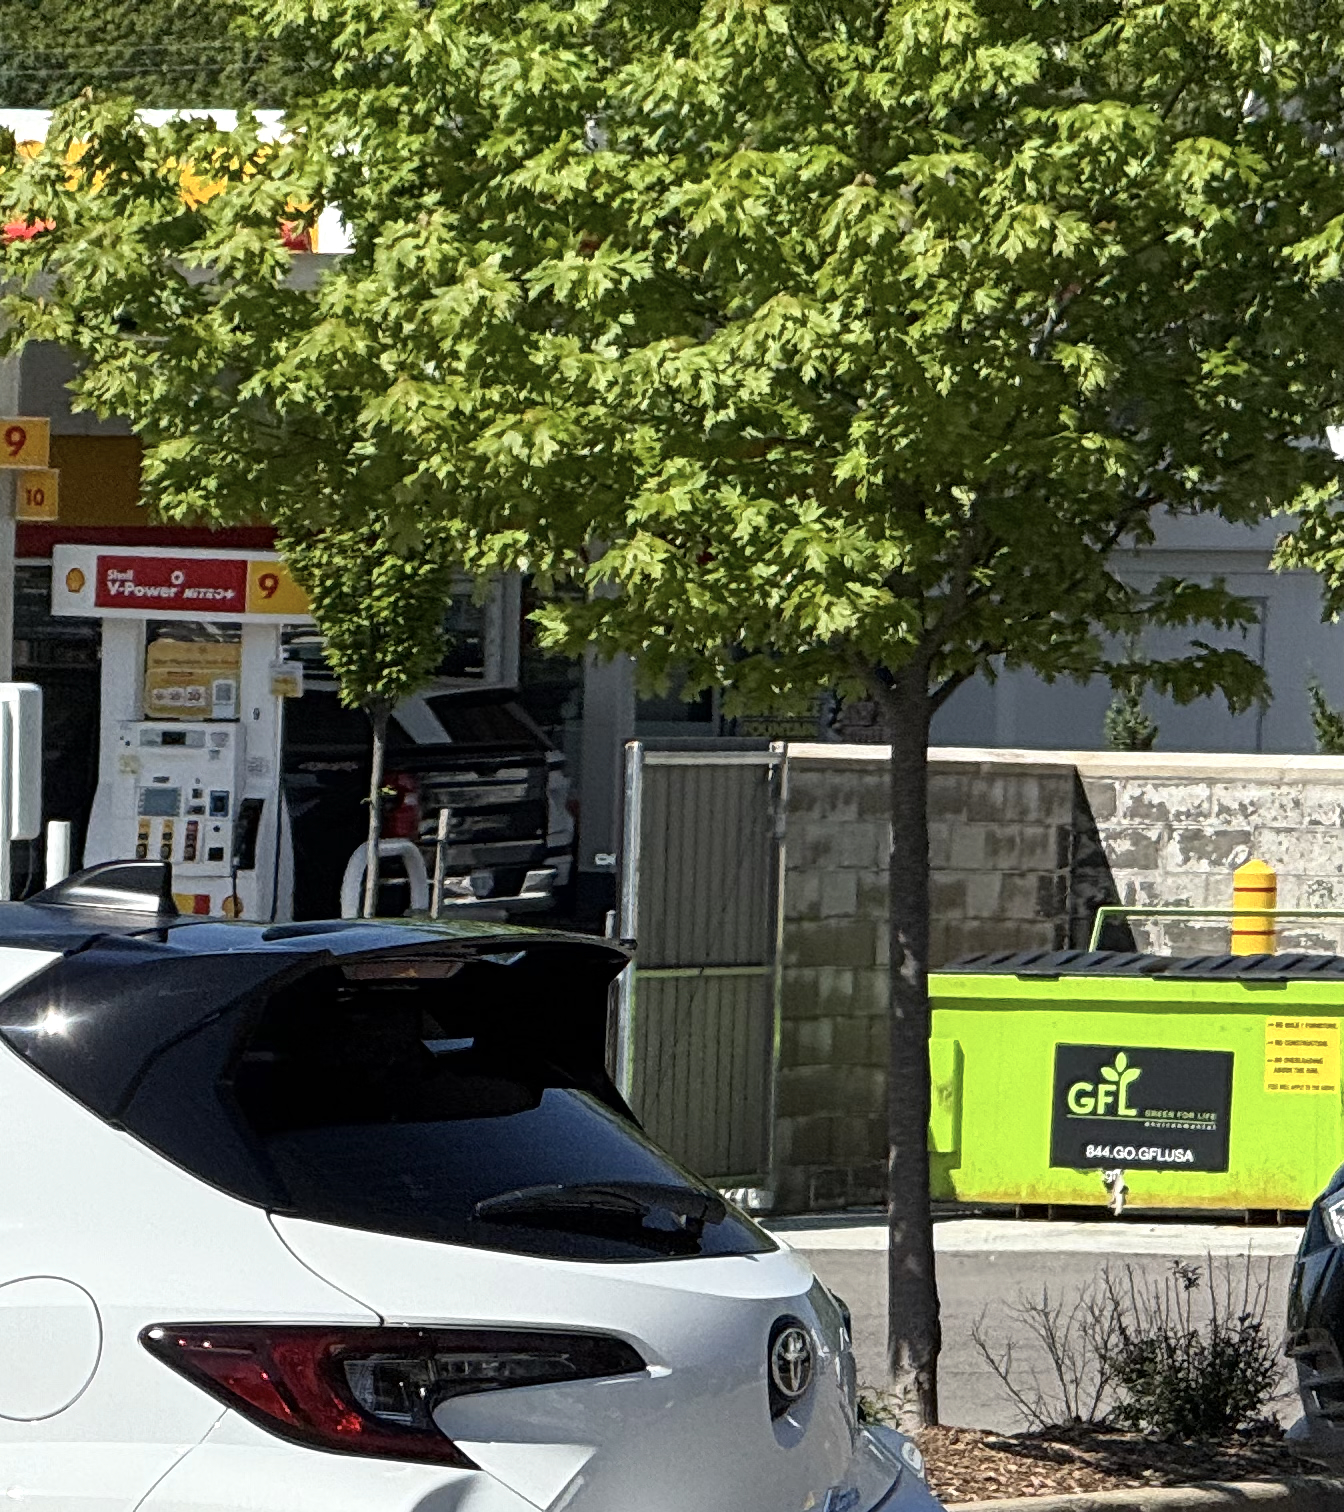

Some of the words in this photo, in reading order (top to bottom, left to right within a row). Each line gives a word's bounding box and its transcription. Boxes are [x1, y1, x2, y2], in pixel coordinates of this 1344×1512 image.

[4, 426, 27, 457] 9
[25, 488, 45, 507] 10
[107, 569, 134, 581] Shell
[107, 581, 179, 599] V-Power
[258, 573, 280, 600] 9
[1067, 1068, 1141, 1117] GFL
[1144, 1109, 1174, 1119] GREEN
[1176, 1110, 1195, 1119] FOR
[1197, 1112, 1217, 1121] LIFE
[1086, 1145, 1195, 1162] 844.GO.GFLUSA
